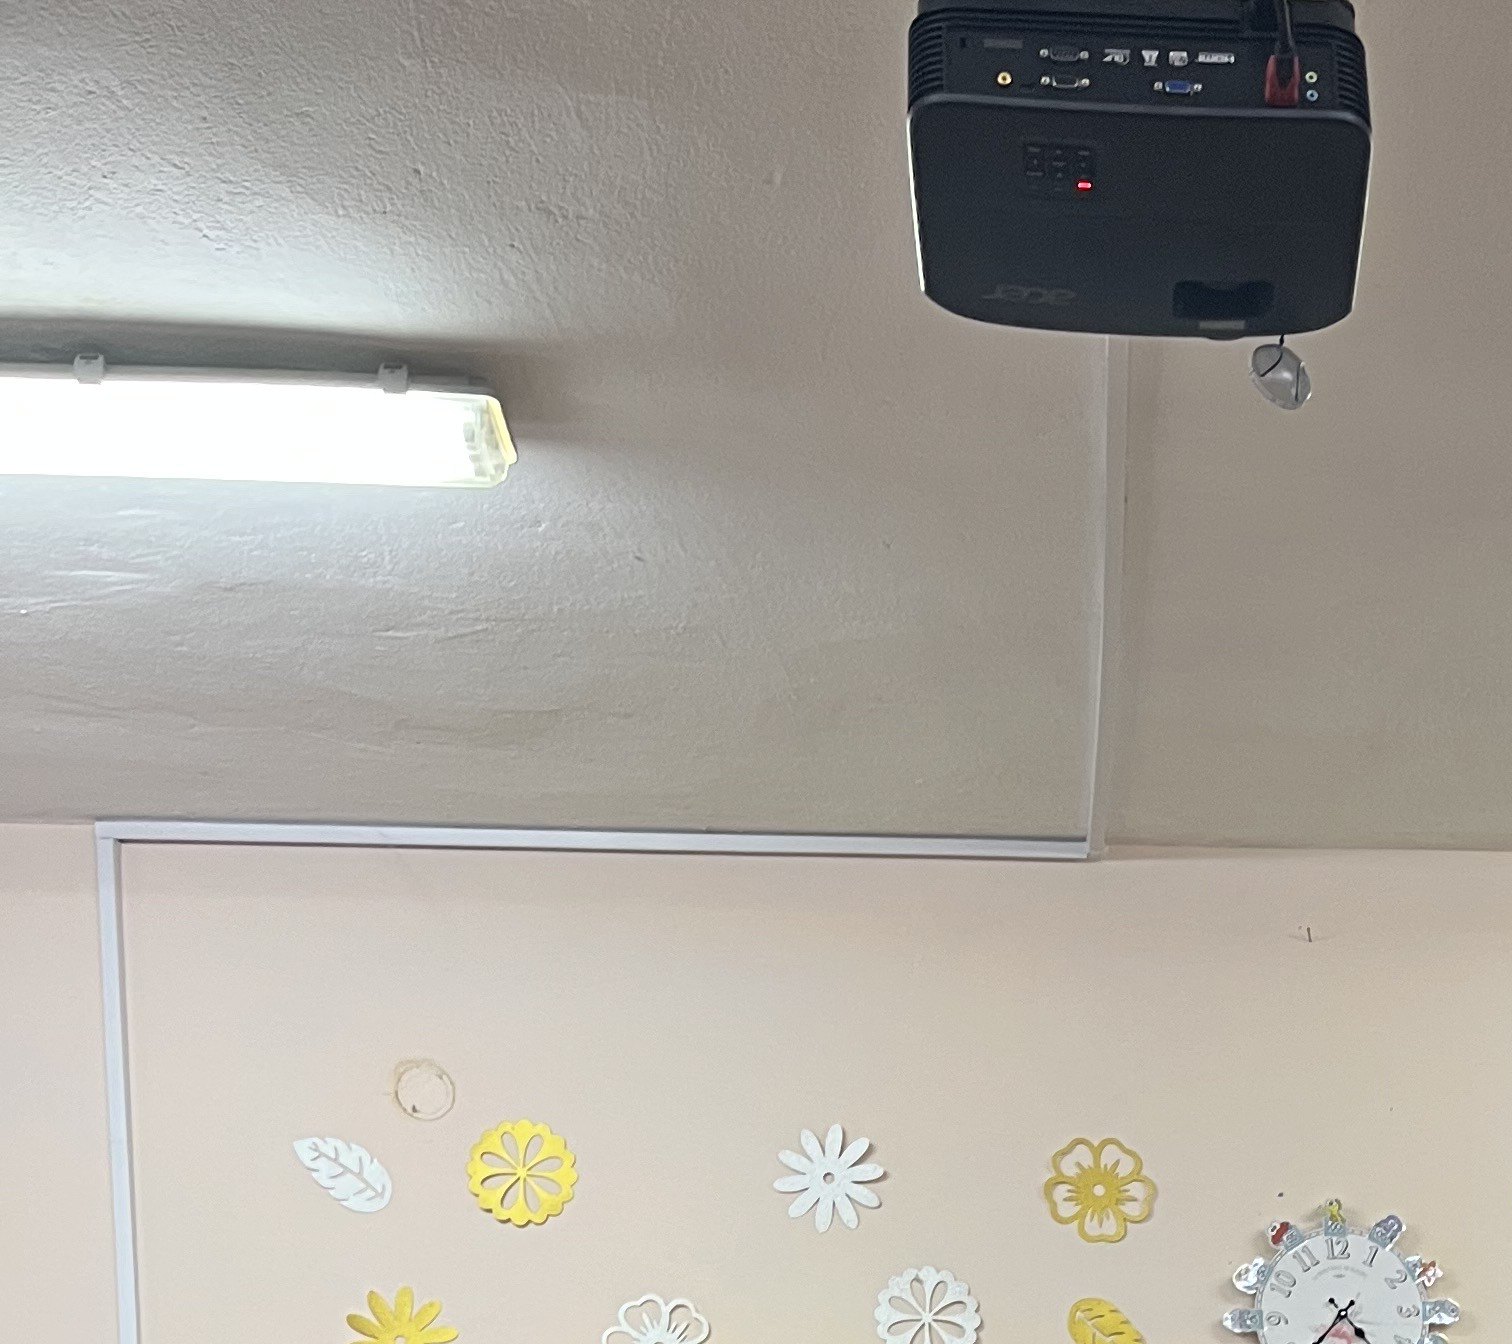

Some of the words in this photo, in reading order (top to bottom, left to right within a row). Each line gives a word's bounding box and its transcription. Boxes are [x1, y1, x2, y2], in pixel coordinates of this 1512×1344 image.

[1293, 1246, 1320, 1272] 11
[1325, 1238, 1350, 1260] 12
[1363, 1246, 1378, 1267] 1
[1270, 1270, 1296, 1298] 10
[1385, 1270, 1407, 1289] 2
[1266, 1311, 1288, 1325] 9
[1397, 1306, 1420, 1318] 3
